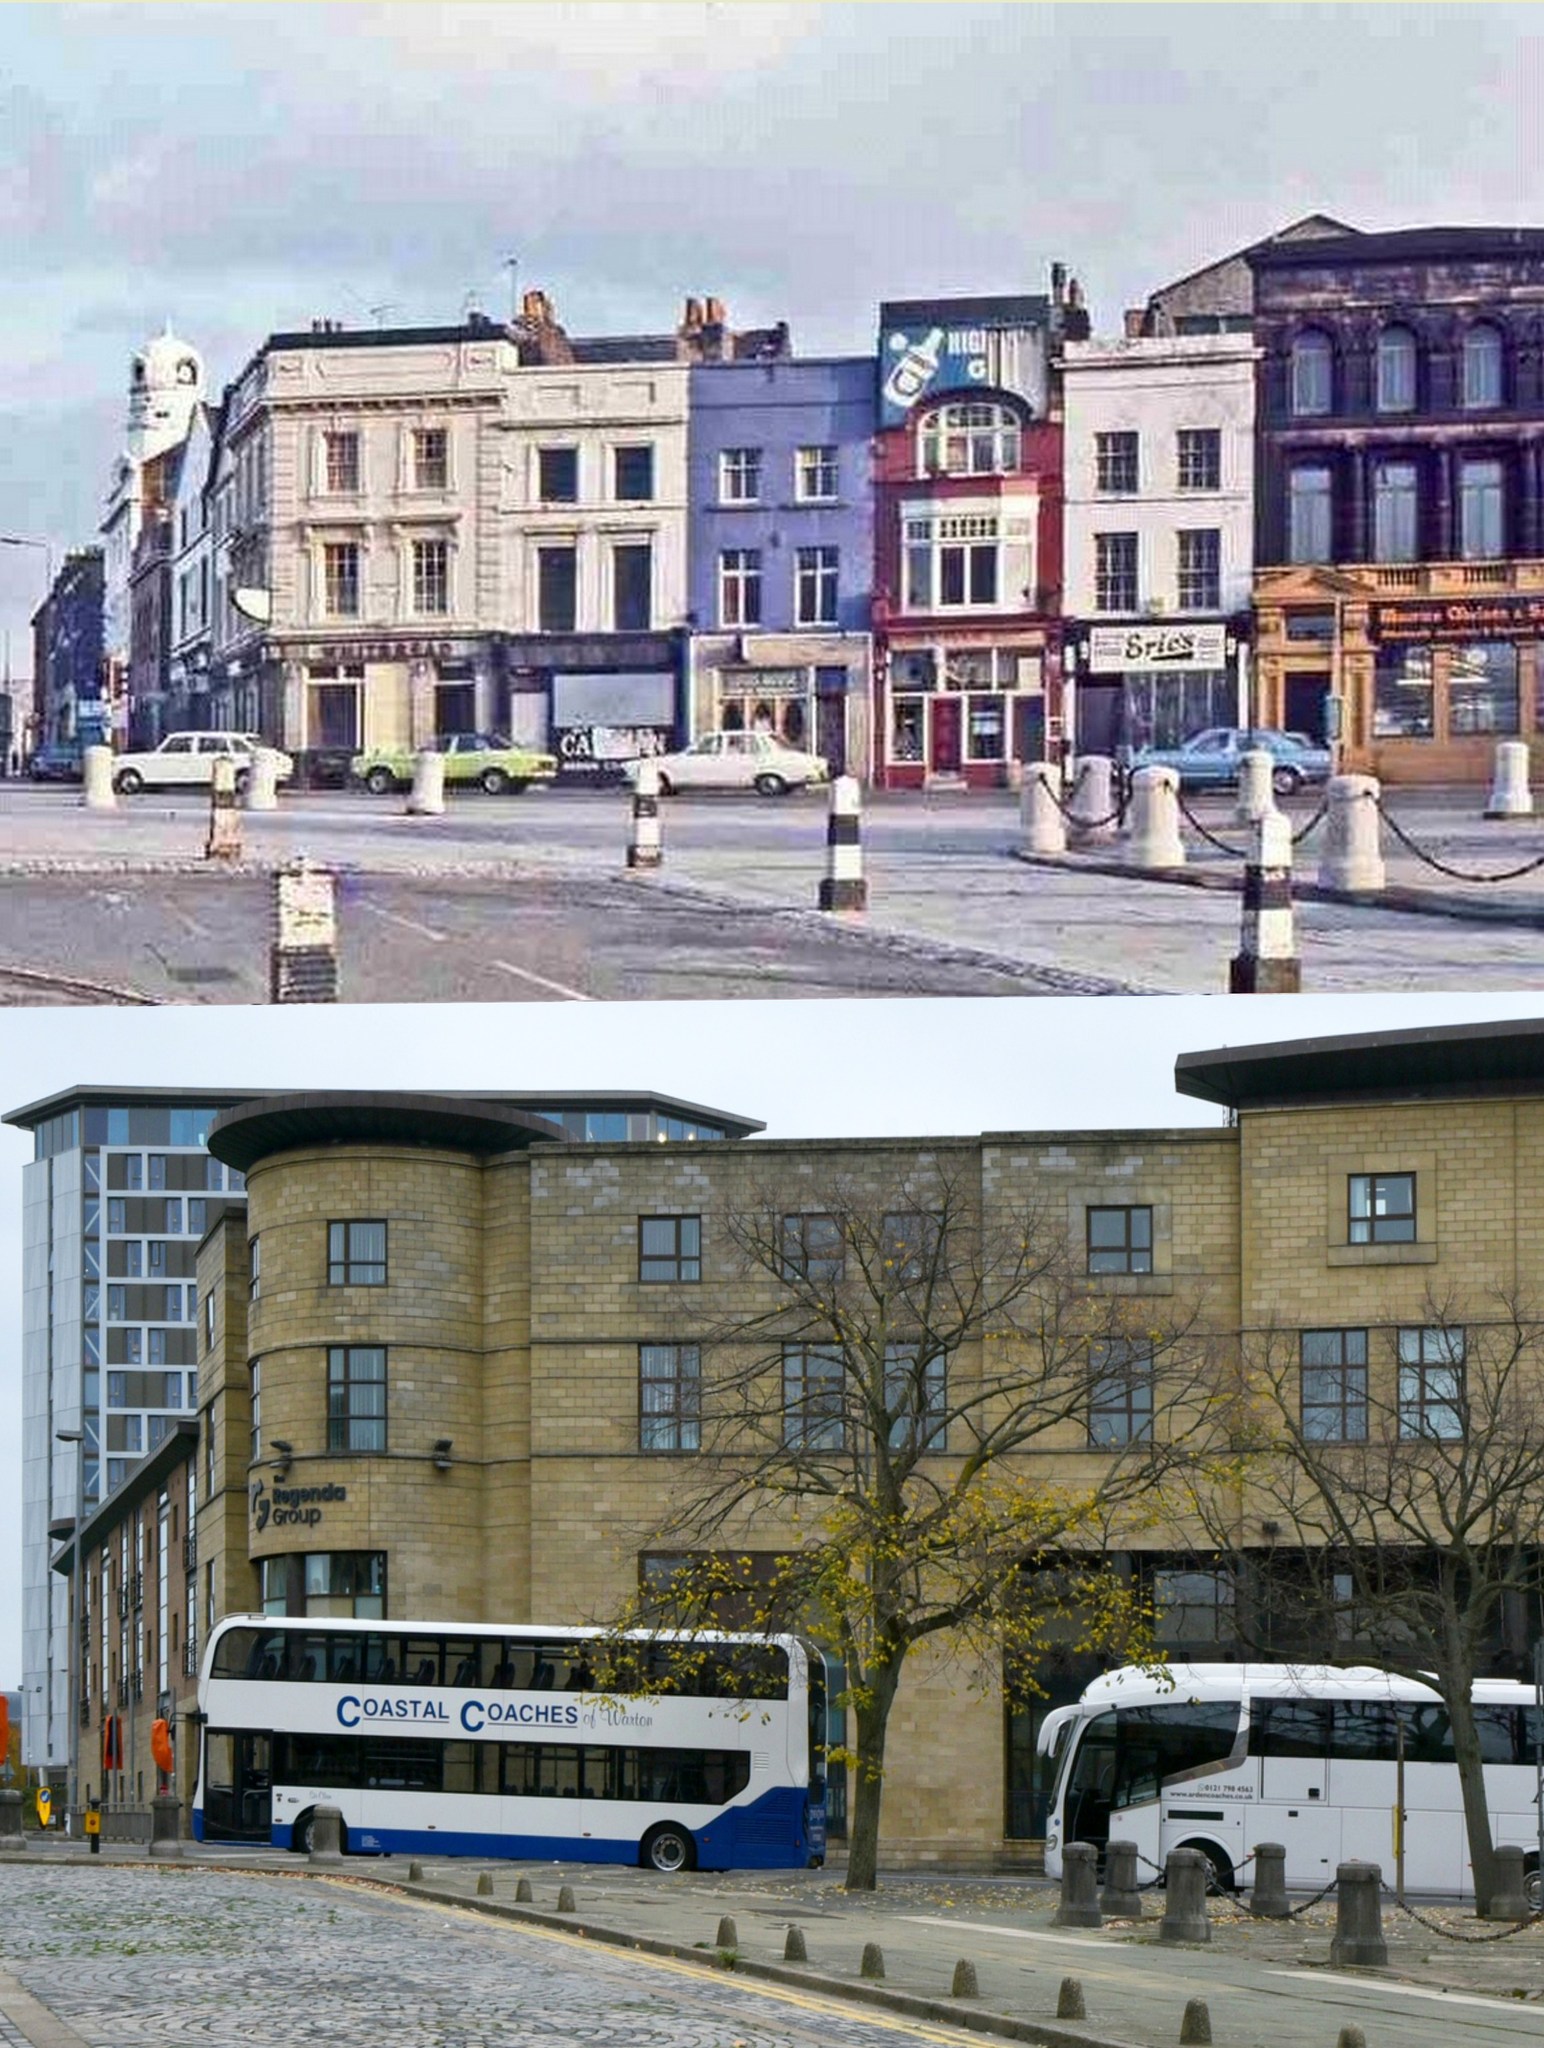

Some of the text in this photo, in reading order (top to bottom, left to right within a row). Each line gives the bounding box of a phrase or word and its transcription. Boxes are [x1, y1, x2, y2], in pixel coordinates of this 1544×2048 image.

[273, 1508, 322, 1528] Group
[337, 1696, 450, 1727] COASTAL
[460, 1700, 578, 1732] COACHES
[1204, 1784, 1221, 1792] 0121
